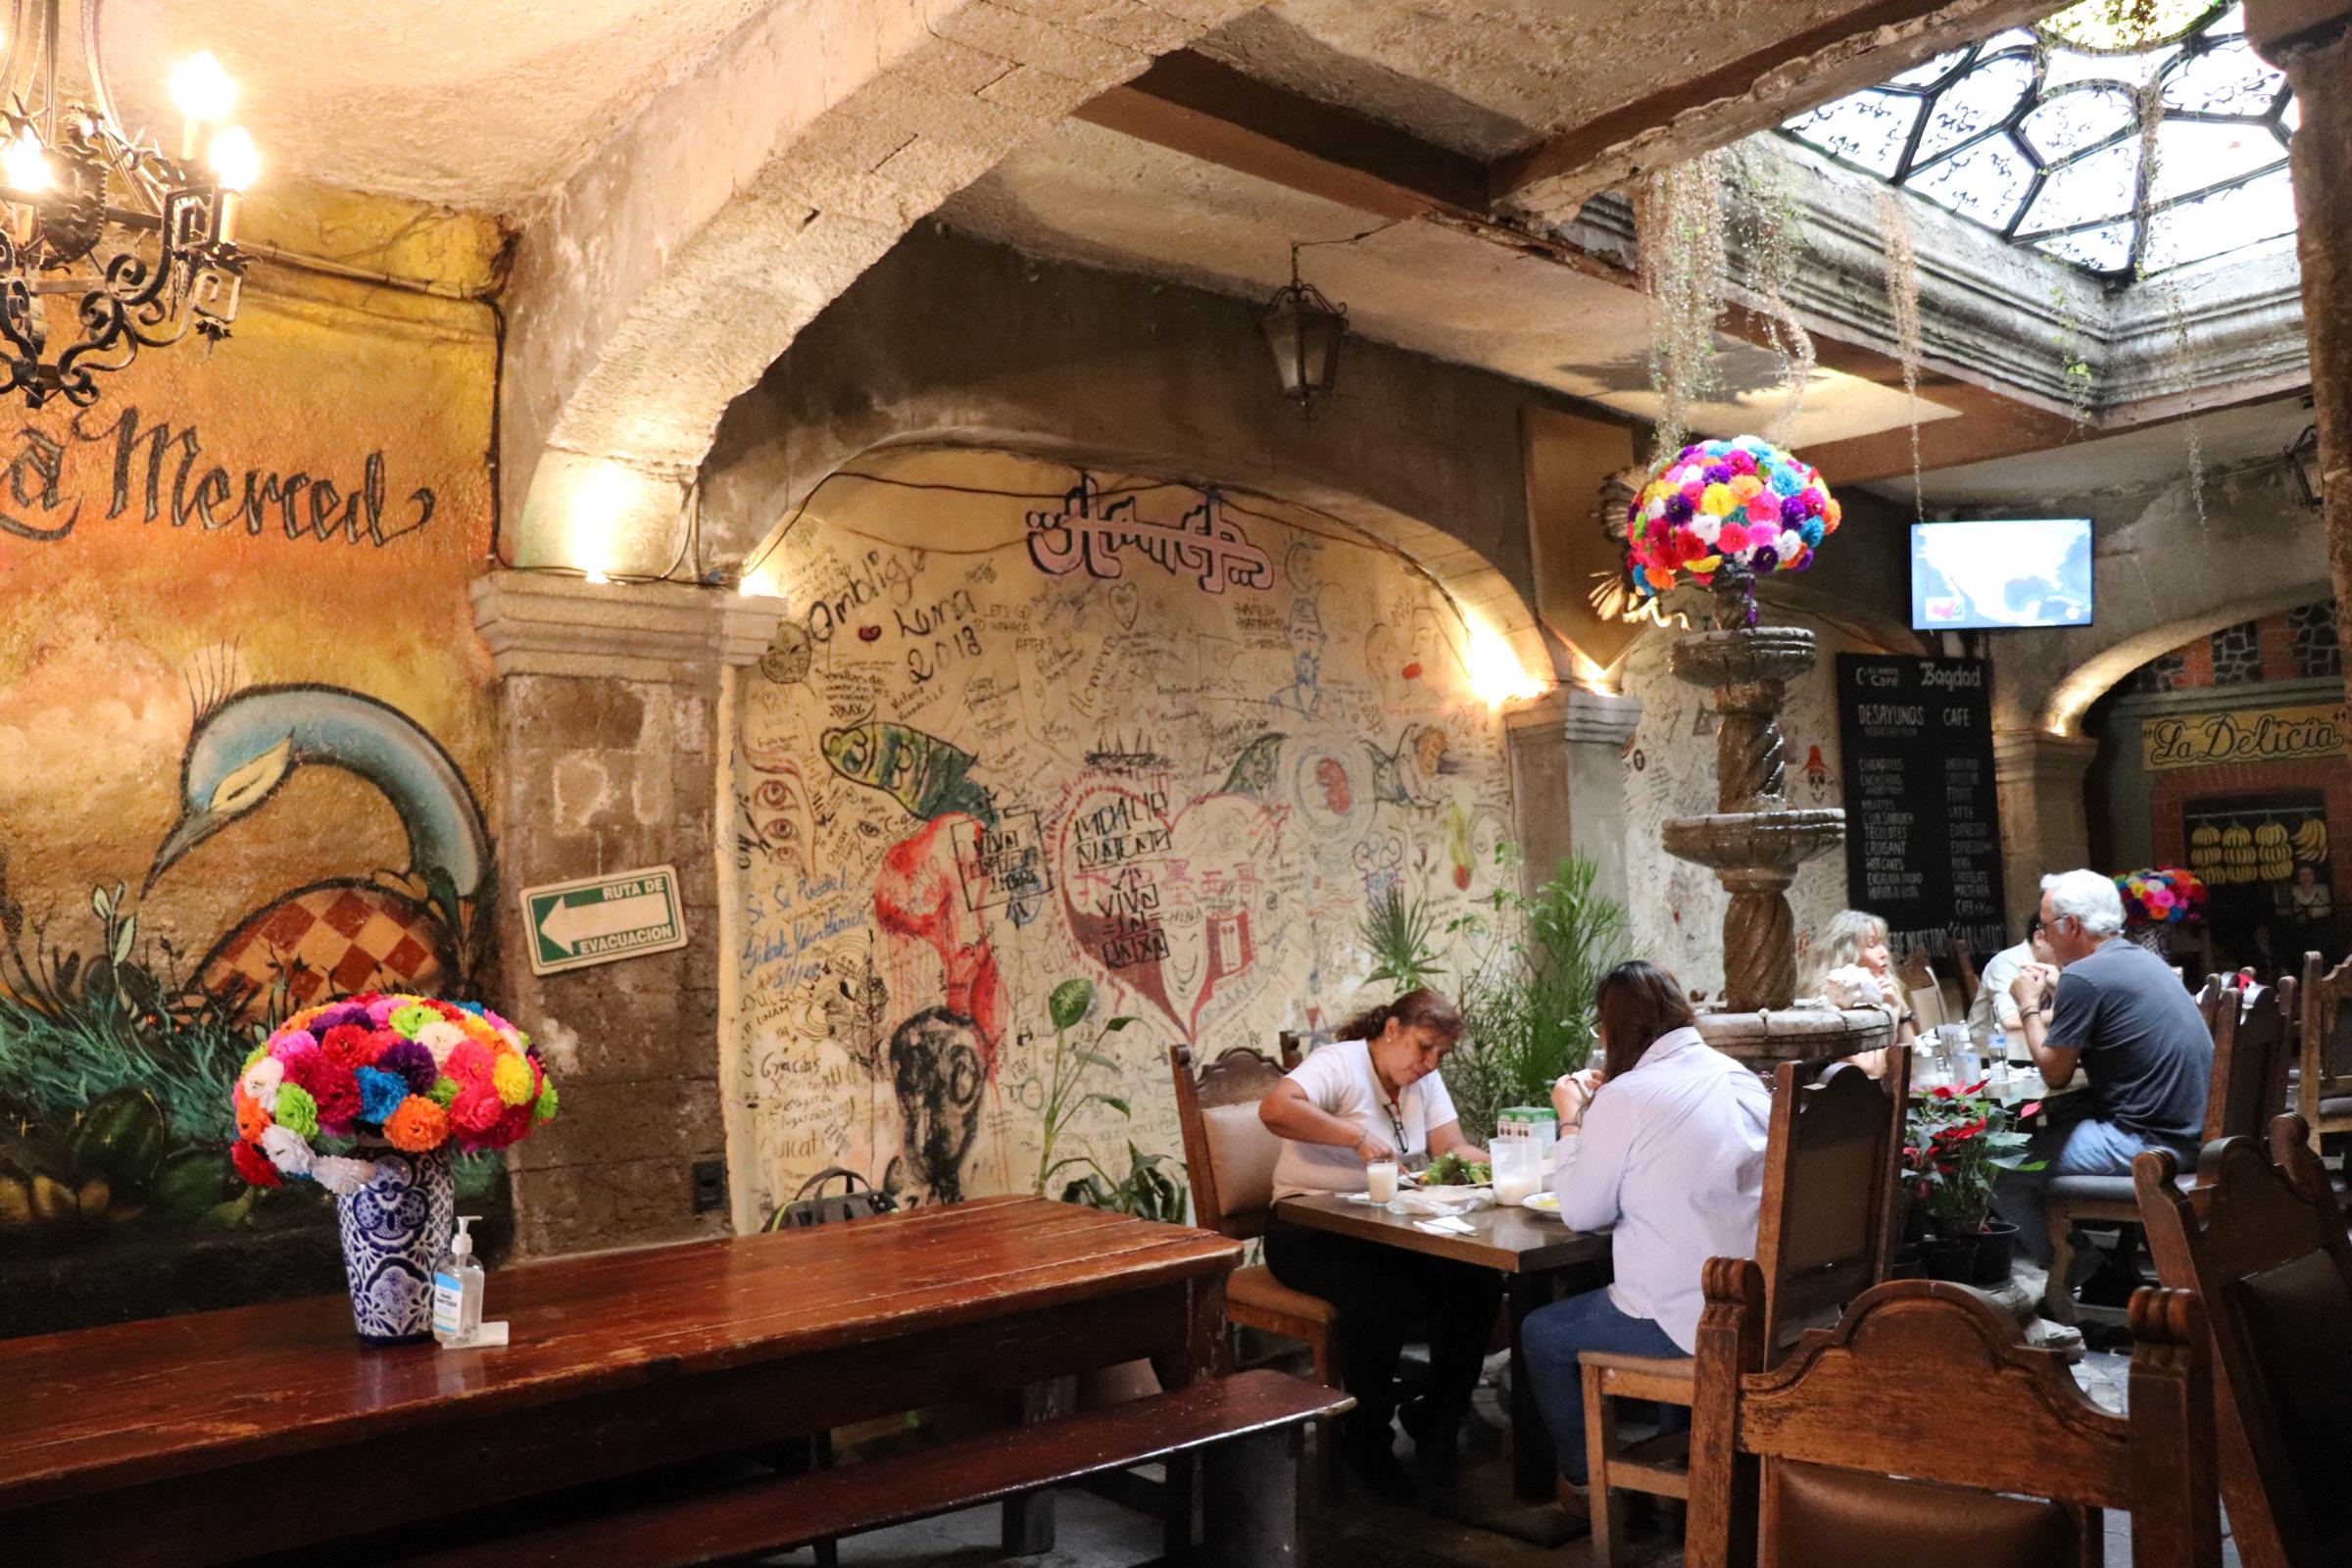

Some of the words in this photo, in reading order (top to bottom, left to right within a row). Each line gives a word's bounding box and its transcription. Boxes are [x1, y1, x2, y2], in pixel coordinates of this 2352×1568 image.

[0, 425, 82, 540] a
[71, 406, 434, 547] Merced
[1920, 662, 1982, 692] Bagdad
[1858, 704, 1925, 727] DESAYUNOS
[602, 881, 643, 901] RUTA
[644, 877, 665, 894] DE
[577, 924, 674, 956] EVACUACION
